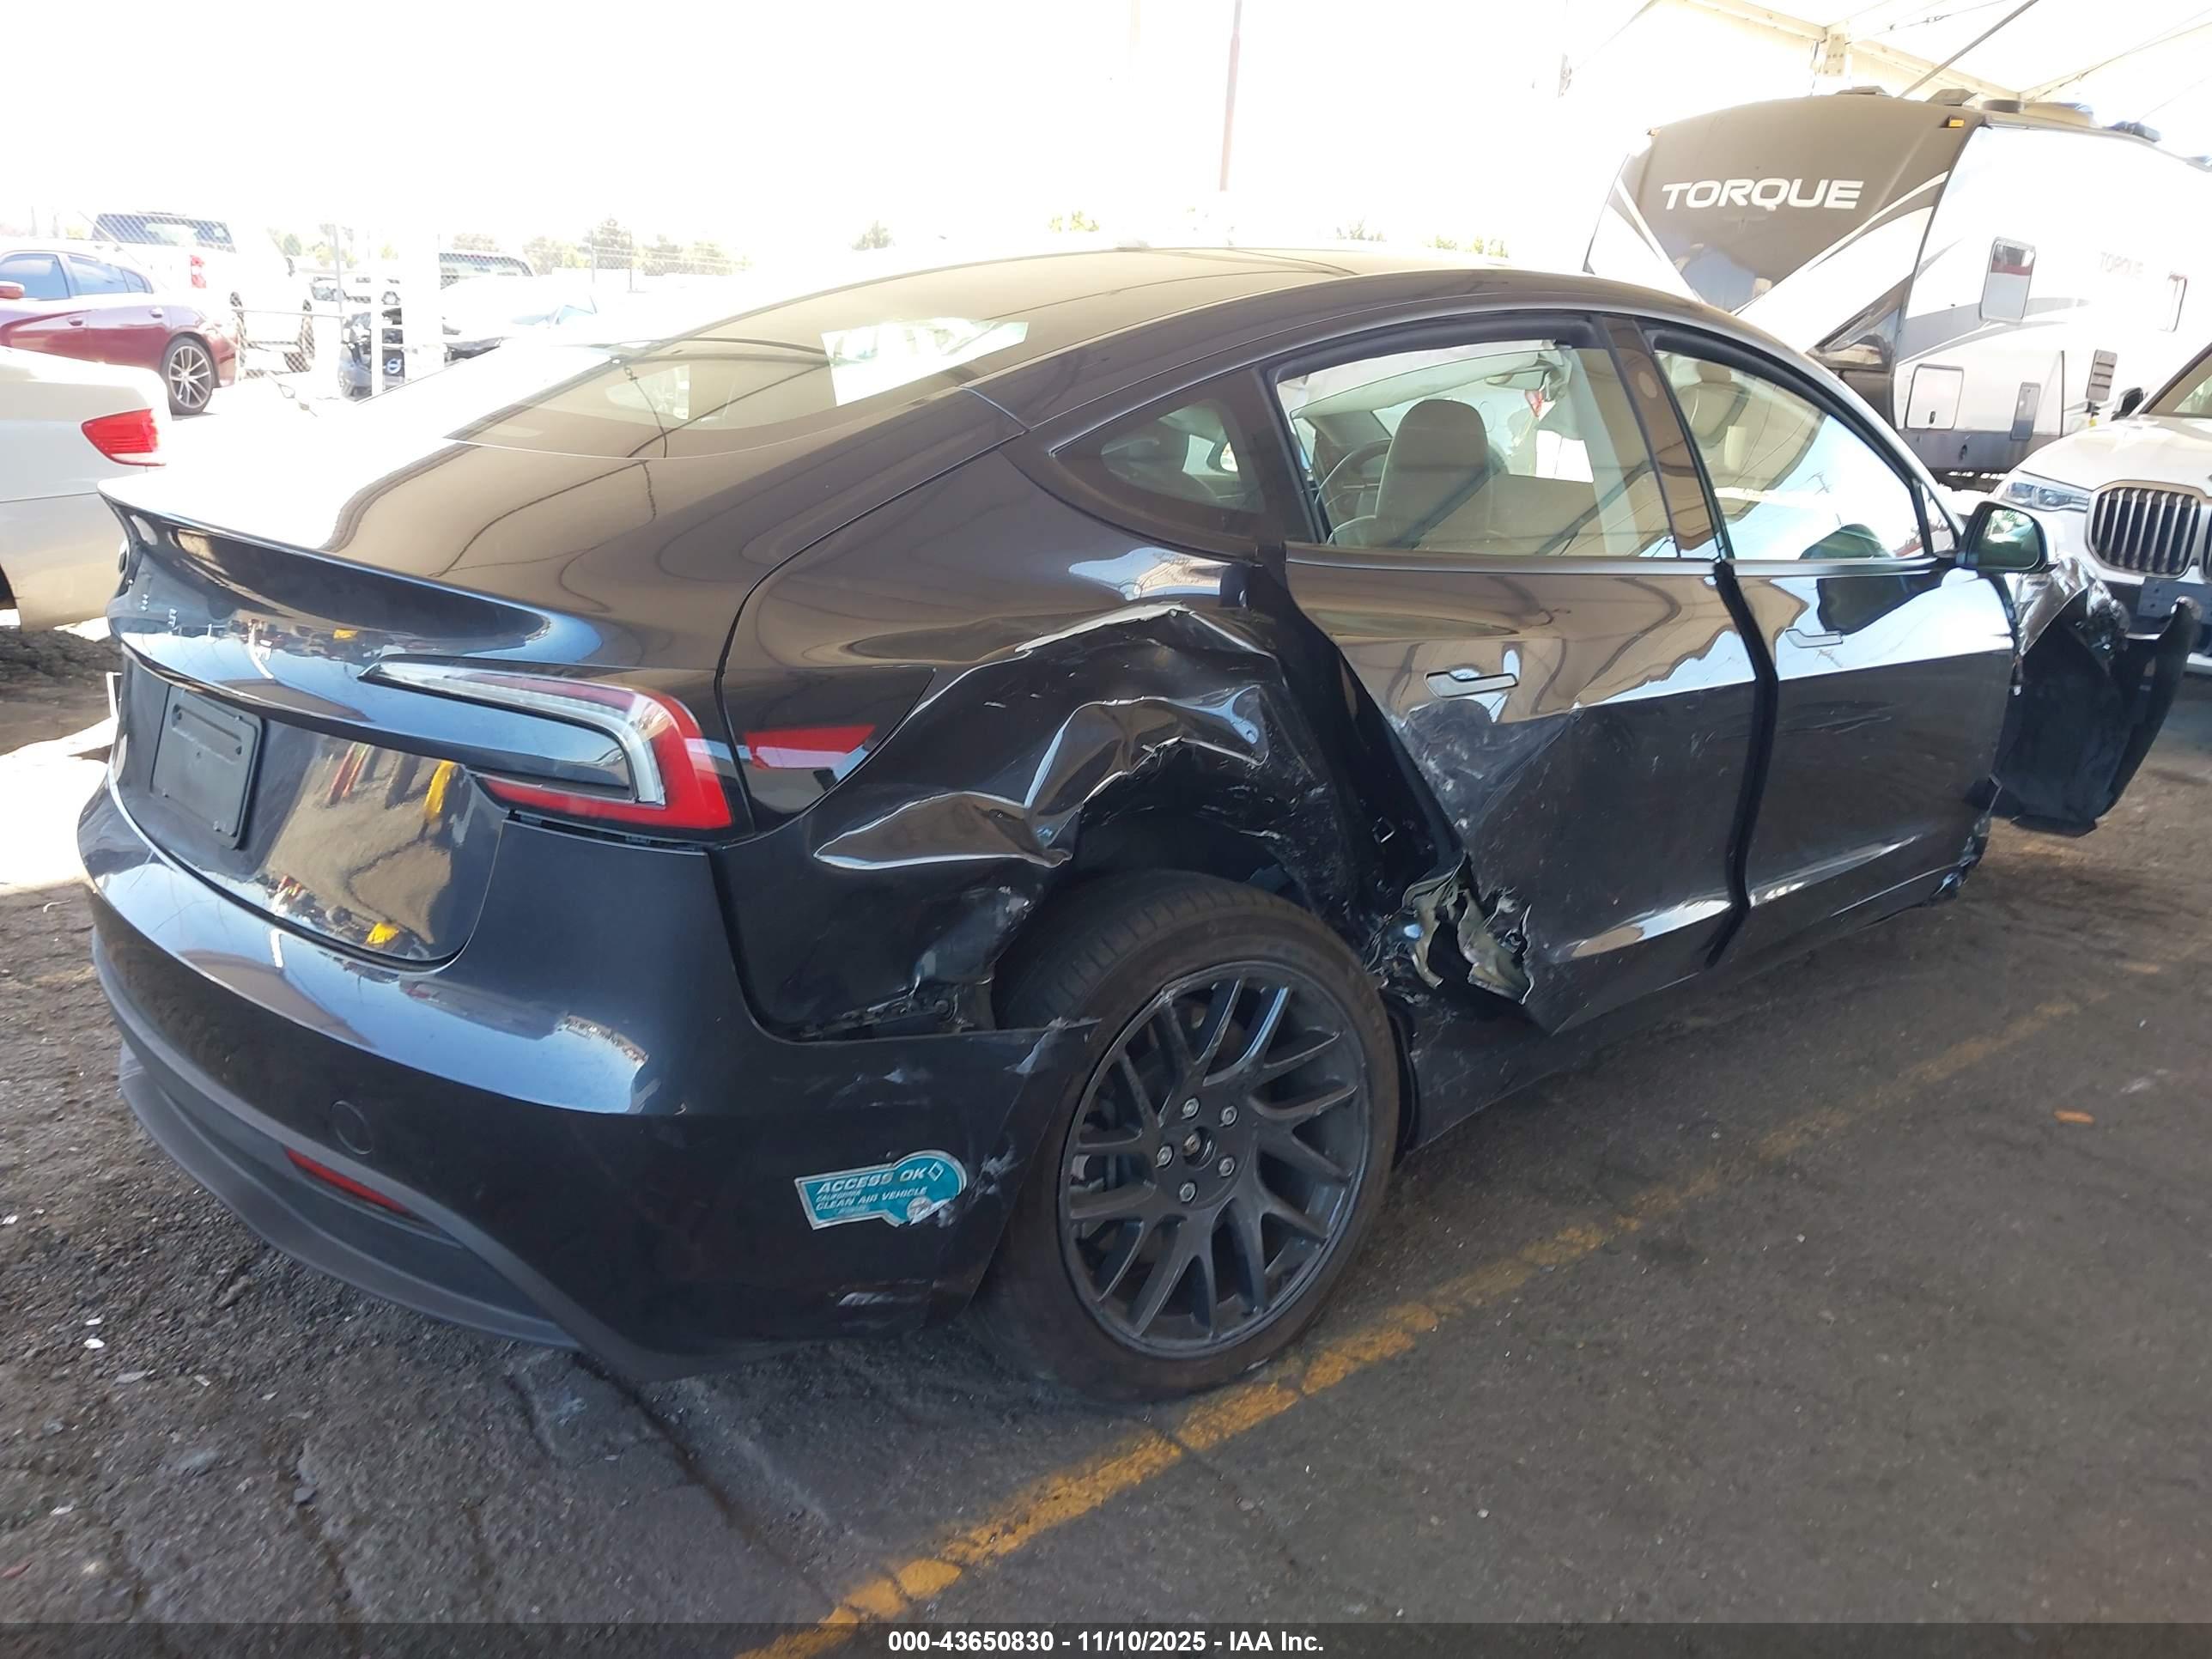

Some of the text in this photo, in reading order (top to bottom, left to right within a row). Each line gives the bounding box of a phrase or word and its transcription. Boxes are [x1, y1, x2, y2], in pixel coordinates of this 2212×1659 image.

[1662, 178, 1864, 211] TORQUE
[817, 1167, 928, 1194] ACCESS OK
[816, 1198, 855, 1212] CLEAN
[858, 1194, 878, 1205] AIR
[881, 1187, 928, 1200] VEHICLE
